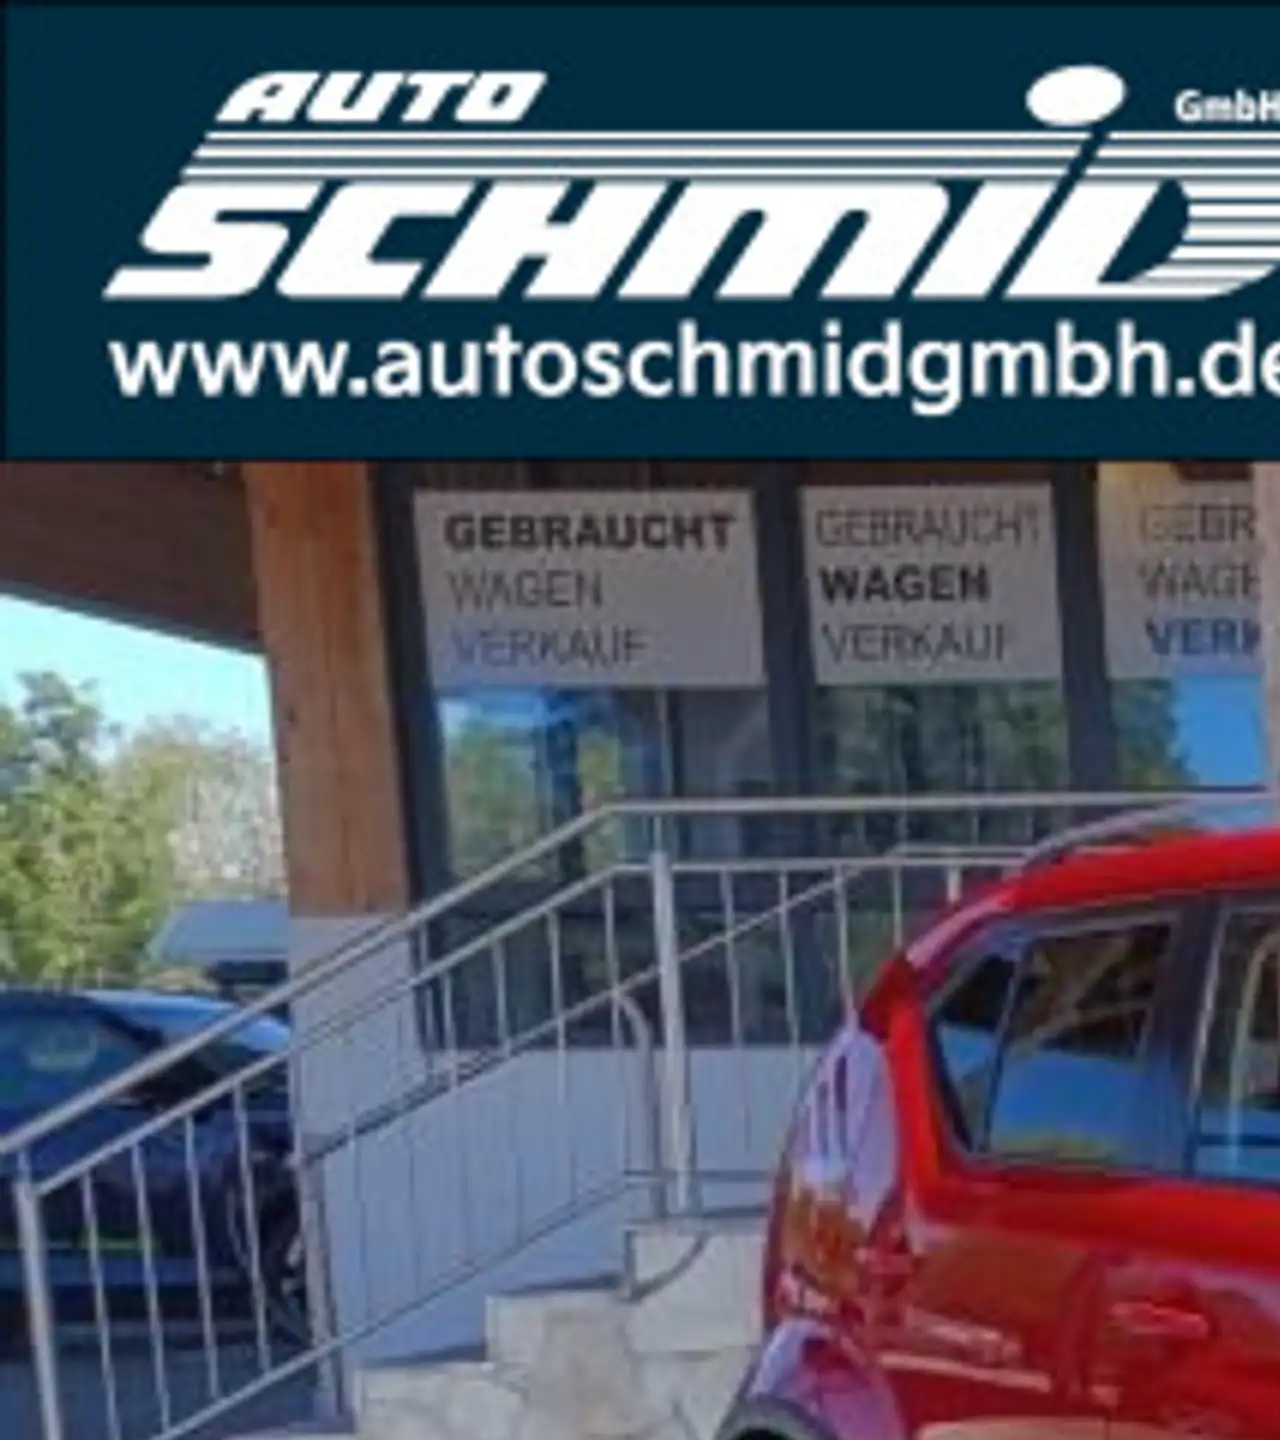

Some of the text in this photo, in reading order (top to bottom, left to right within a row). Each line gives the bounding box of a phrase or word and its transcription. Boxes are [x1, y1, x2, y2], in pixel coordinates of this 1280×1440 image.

[442, 511, 740, 552] GEBRAUCHT
[814, 503, 1042, 548] GEBRAUCHT
[443, 568, 604, 613] WAGEN
[818, 562, 990, 607] WAGEN
[1137, 558, 1262, 601] WAGE
[451, 623, 652, 668] VERKAUF
[820, 620, 1010, 665] VERKAUF
